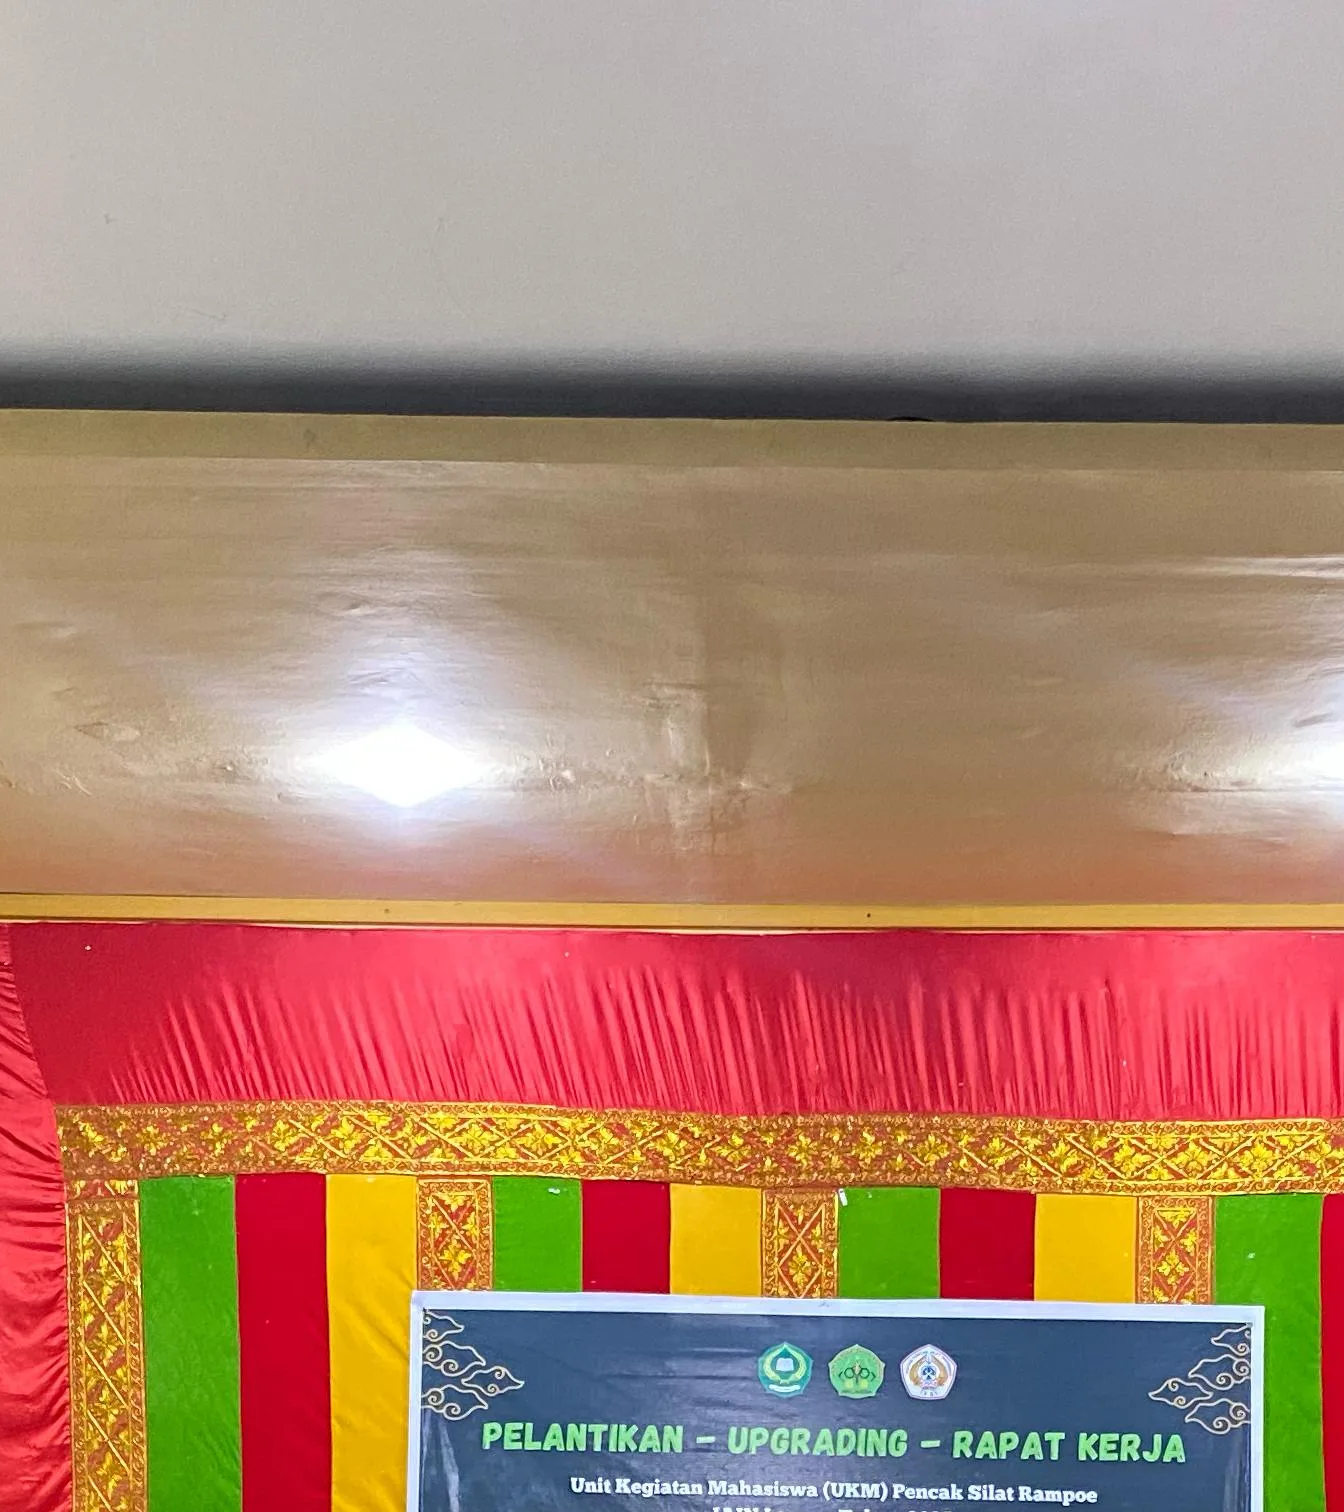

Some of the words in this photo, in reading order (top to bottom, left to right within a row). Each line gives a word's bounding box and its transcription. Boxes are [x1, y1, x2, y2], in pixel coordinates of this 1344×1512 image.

[482, 1421, 684, 1454] PELANTIKAN
[727, 1426, 908, 1458] UPGRADING
[952, 1430, 1066, 1461] RAPAT
[1077, 1432, 1187, 1464] KERJA
[570, 1476, 611, 1494] Unit
[615, 1476, 703, 1498] Kegiatan
[708, 1480, 819, 1498] Mahasiswa
[823, 1481, 889, 1502] (UKM)
[892, 1483, 964, 1501] Pencak
[967, 1484, 1016, 1503] Silat
[1018, 1486, 1099, 1507] Rampoe
